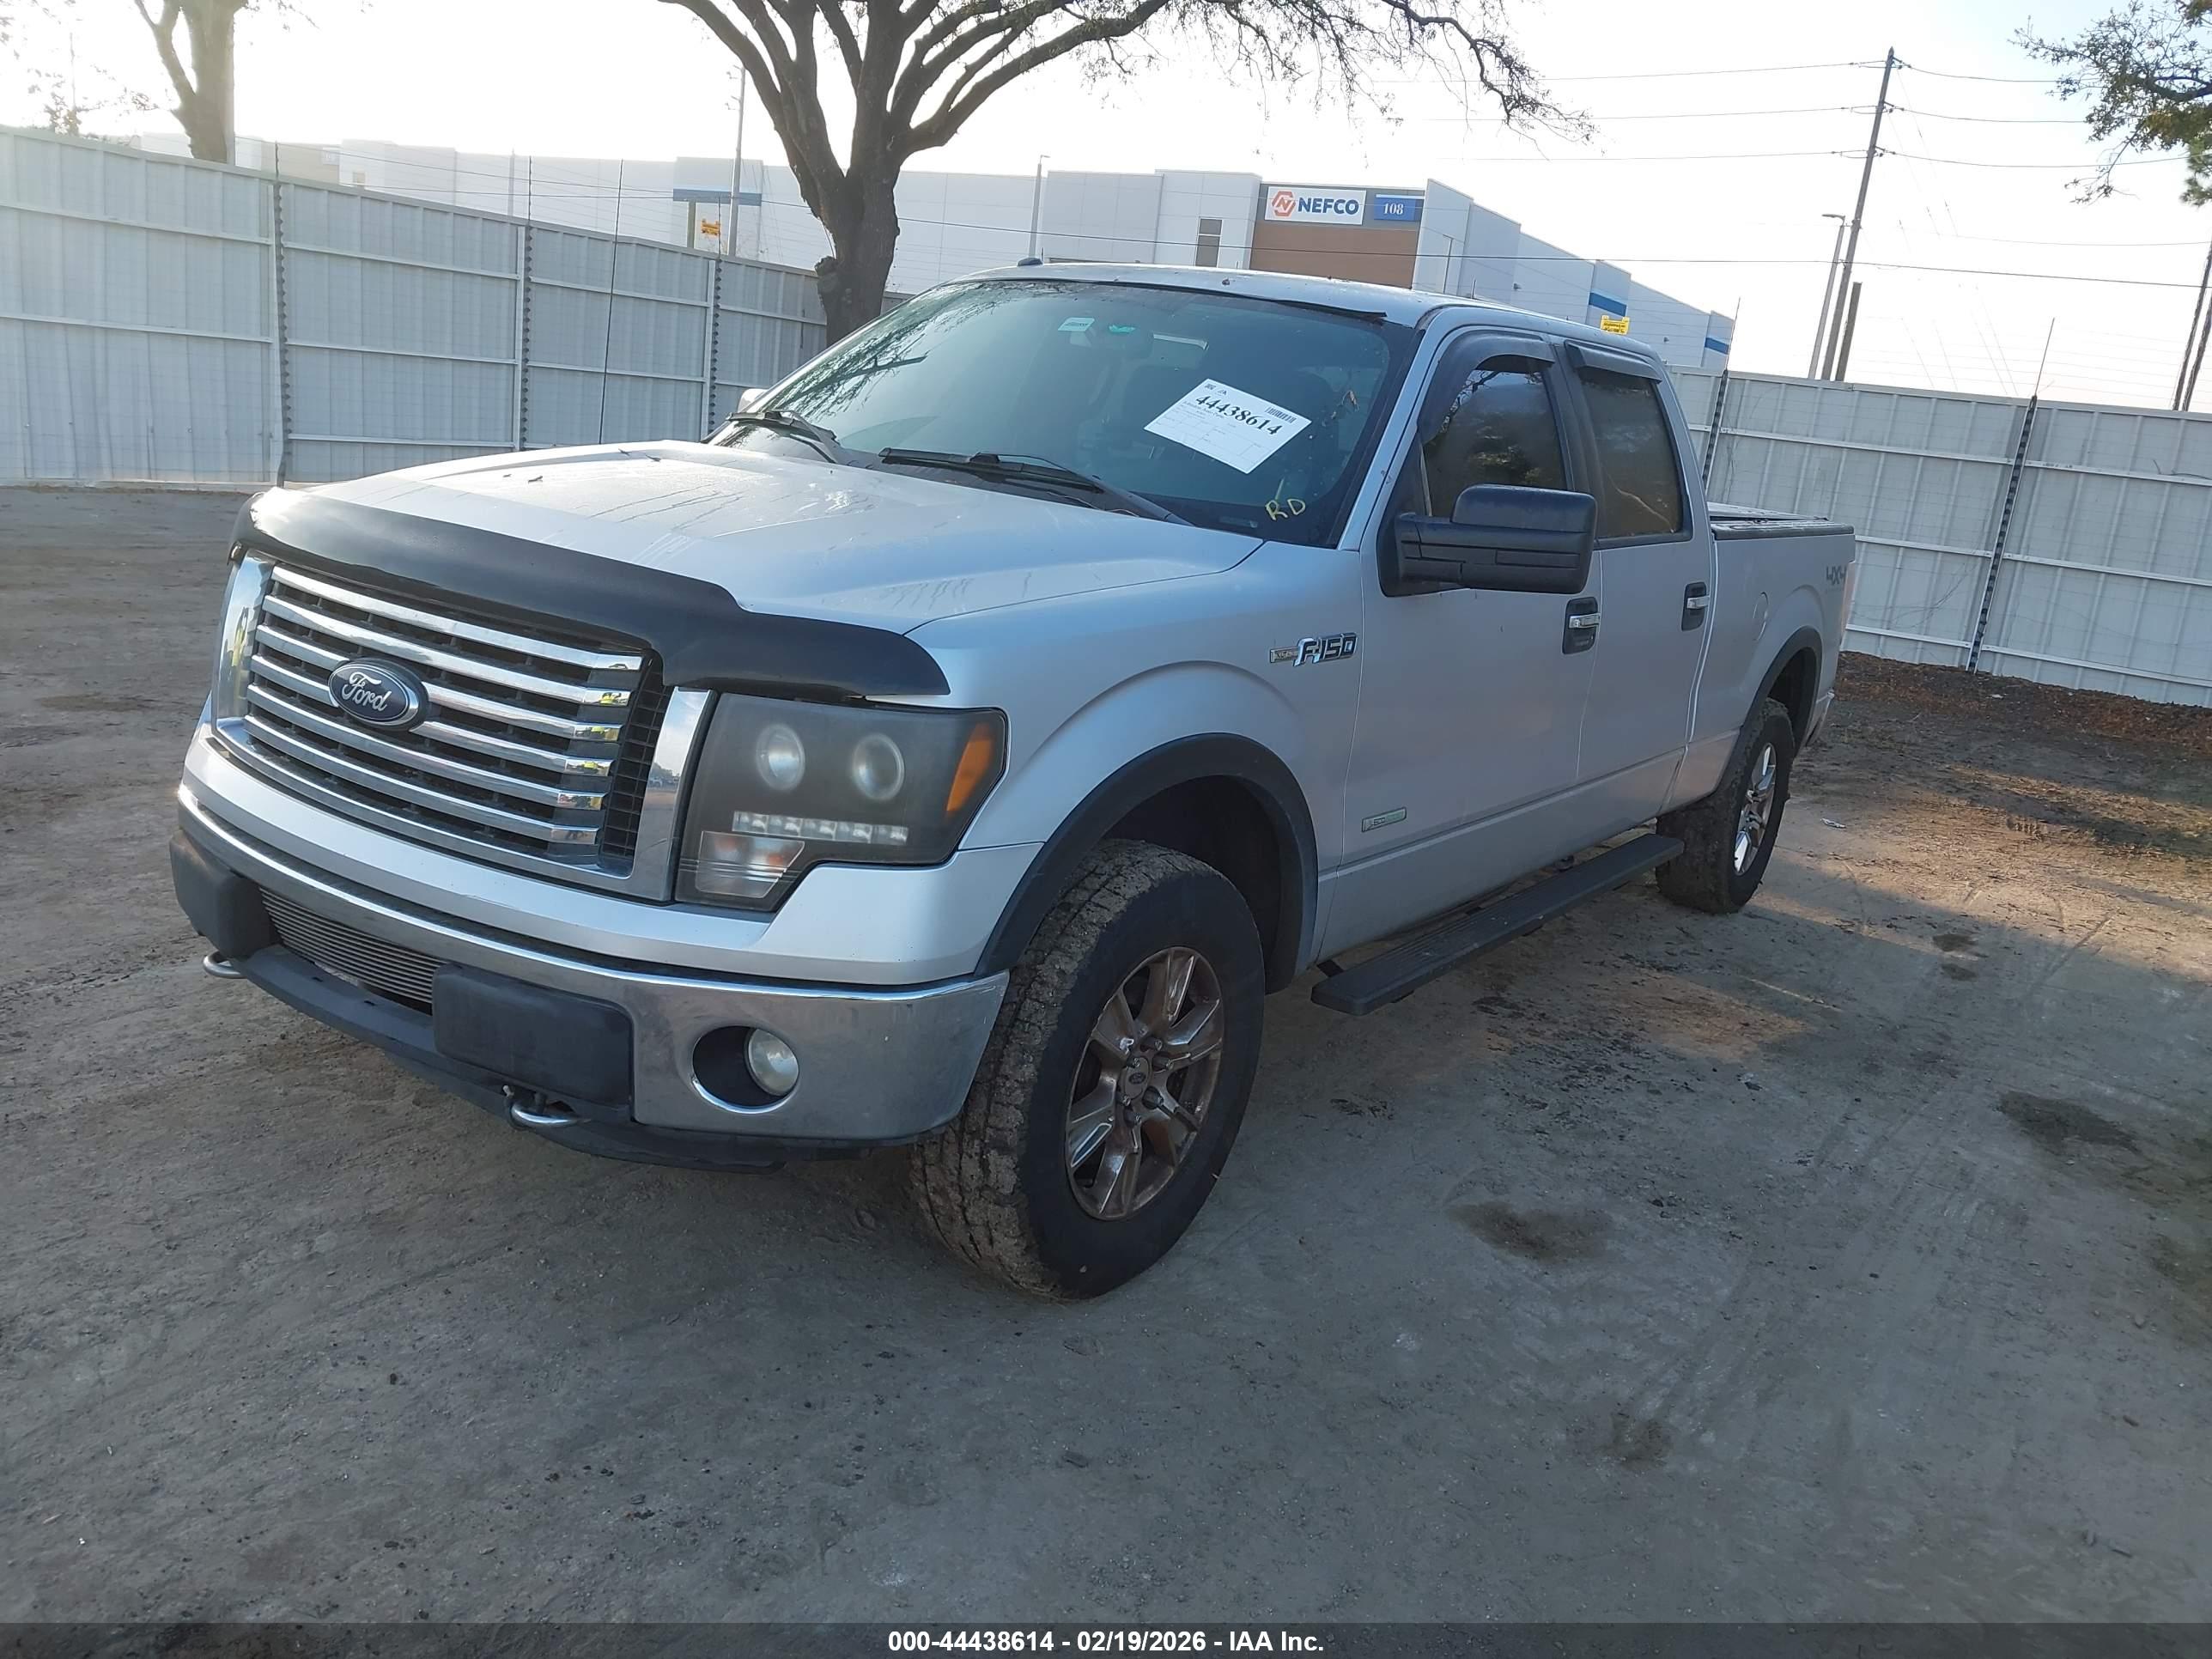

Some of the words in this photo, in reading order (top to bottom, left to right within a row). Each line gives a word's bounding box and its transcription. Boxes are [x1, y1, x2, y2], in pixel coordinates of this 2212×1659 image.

[1297, 198, 1359, 215] NEFCO
[1382, 202, 1405, 215] 108
[1195, 395, 1283, 435] 44438614
[341, 672, 392, 712] Ford
